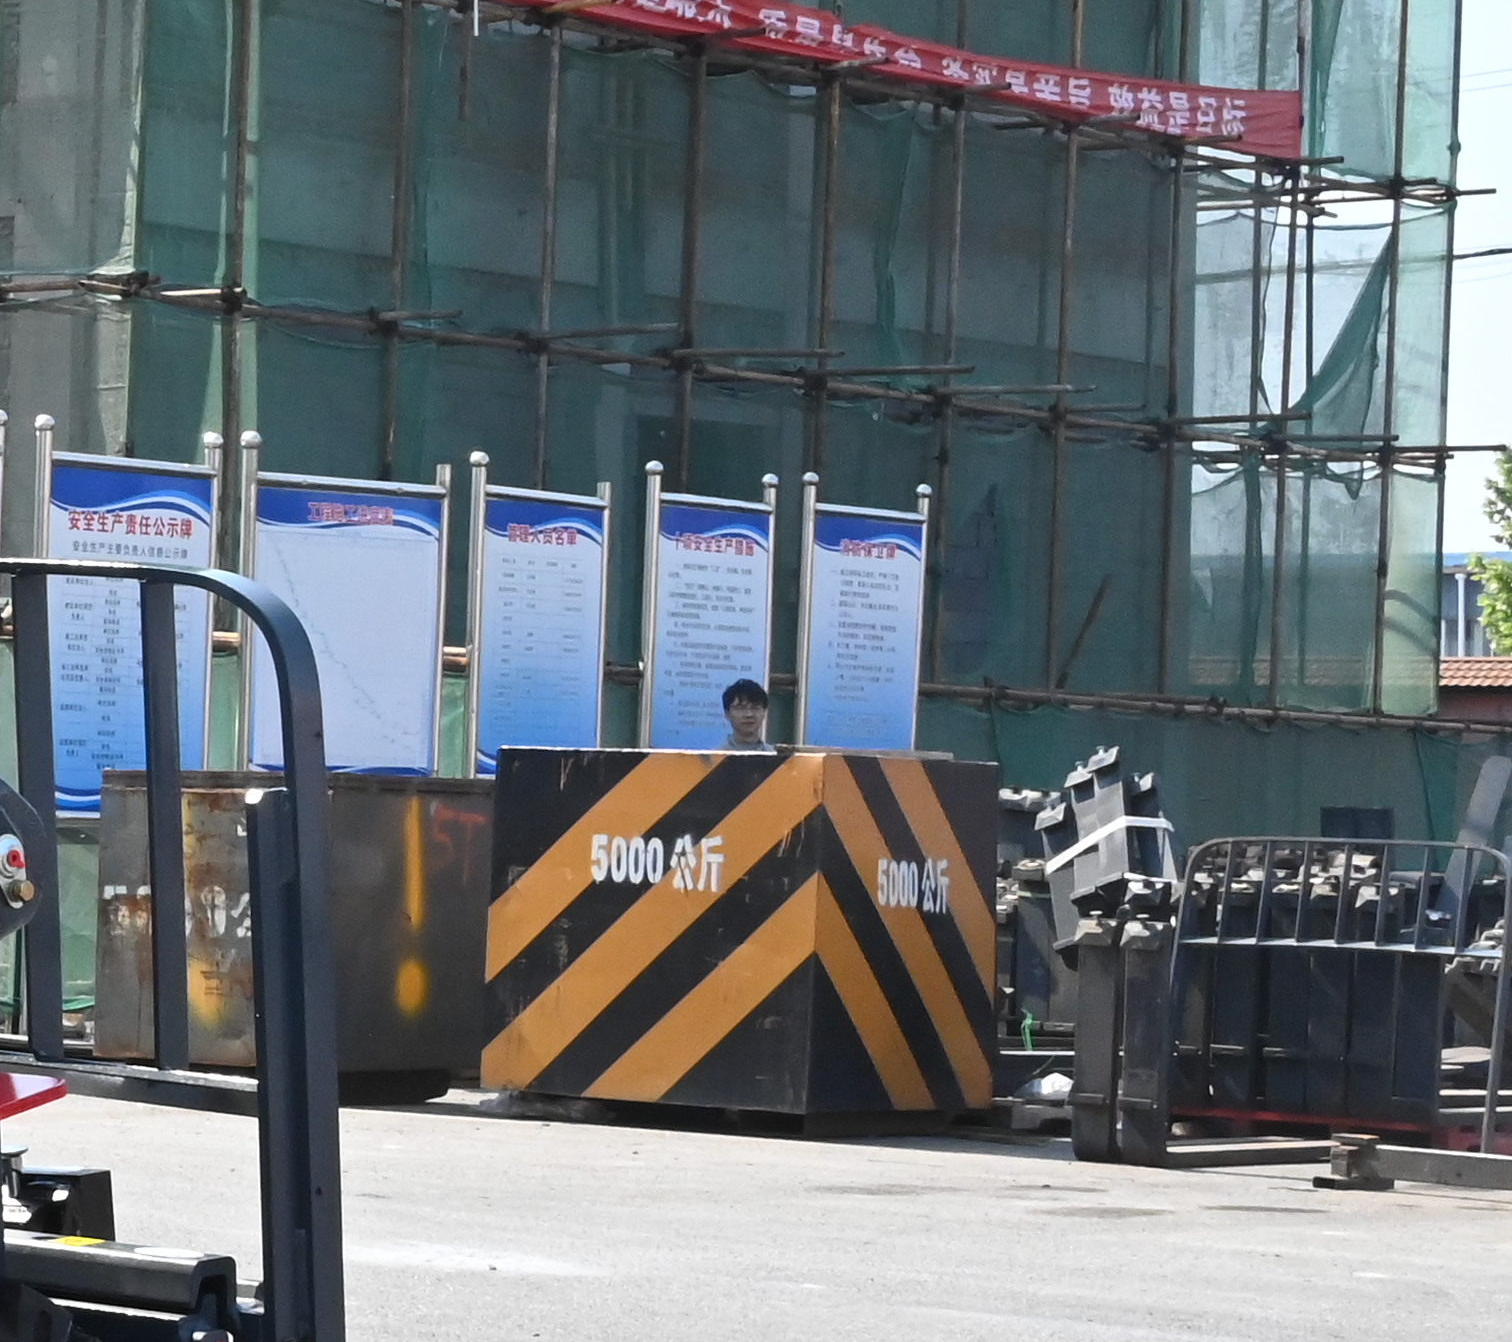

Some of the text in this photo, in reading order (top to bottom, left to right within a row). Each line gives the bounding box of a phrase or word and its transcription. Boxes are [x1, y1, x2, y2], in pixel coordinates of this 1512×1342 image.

[68, 509, 193, 539] 安全生产责任公示牌
[507, 523, 578, 547] 管理人员名单
